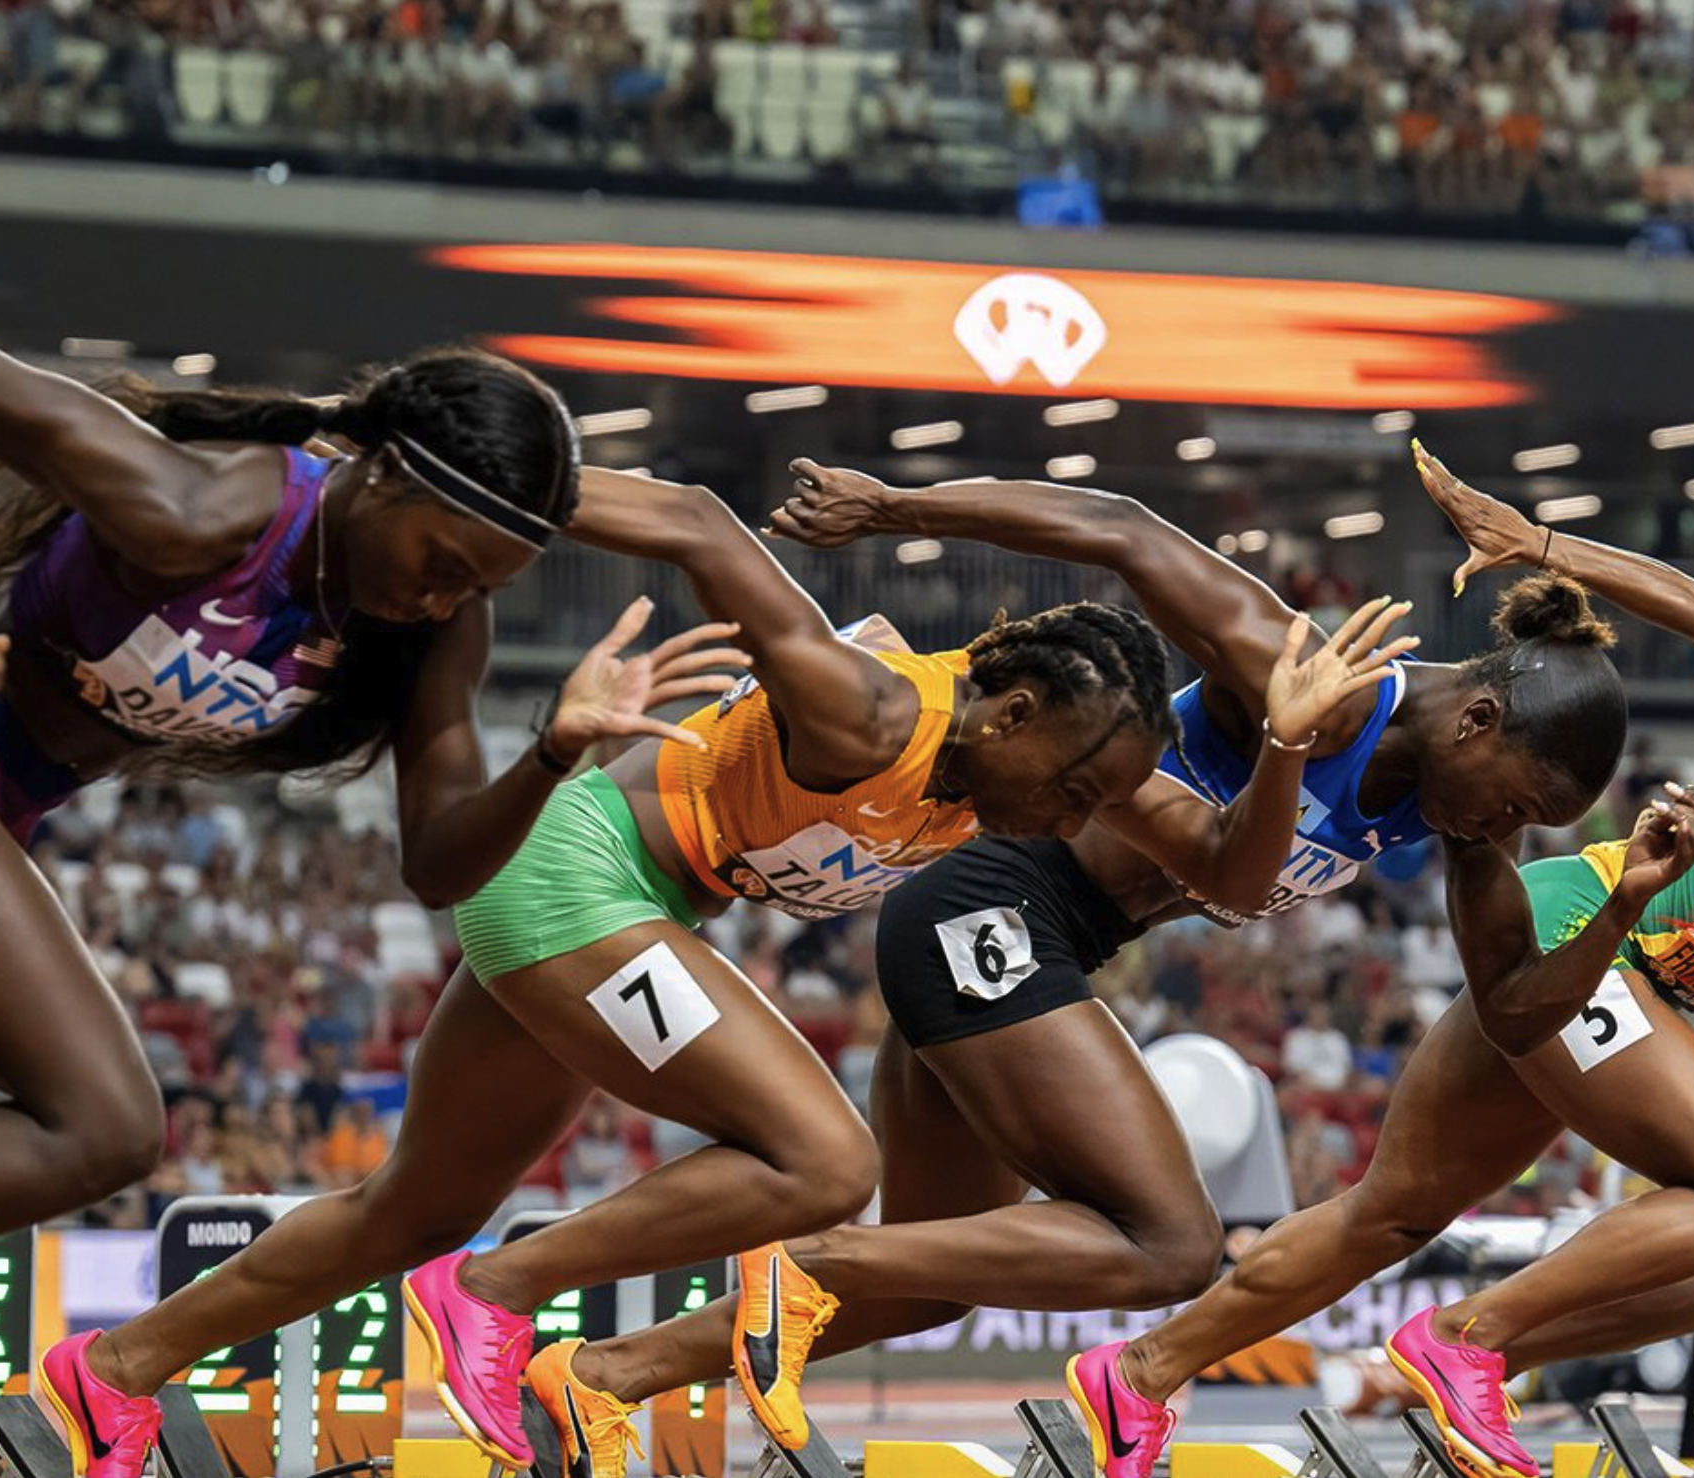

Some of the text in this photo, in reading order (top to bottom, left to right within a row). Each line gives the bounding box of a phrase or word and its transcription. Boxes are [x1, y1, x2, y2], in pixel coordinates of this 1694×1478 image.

[767, 860, 883, 908] TA LO
[973, 923, 1008, 984] 6
[618, 970, 670, 1043] 7
[1580, 1005, 1618, 1047] 5
[188, 1221, 252, 1247] MONDO
[334, 1282, 388, 1412] 2
